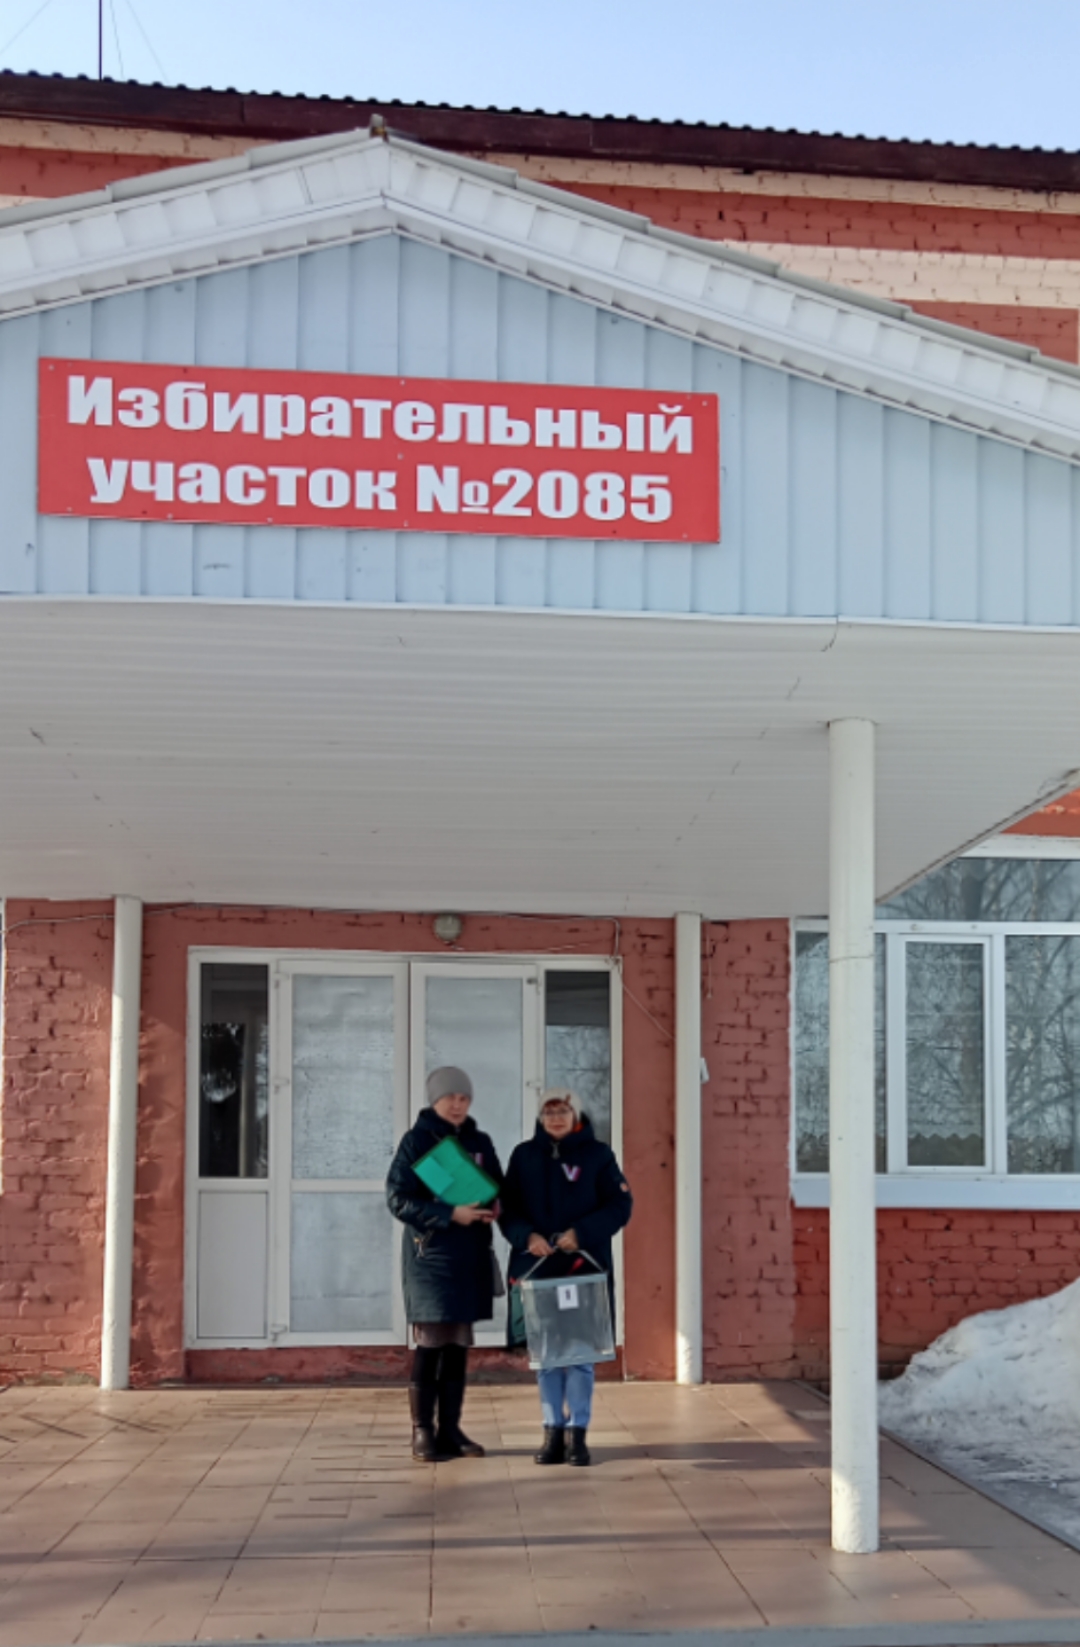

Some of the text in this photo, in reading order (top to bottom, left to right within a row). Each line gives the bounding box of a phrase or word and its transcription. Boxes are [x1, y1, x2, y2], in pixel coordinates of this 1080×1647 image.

[67, 375, 694, 455] Избирательный
[86, 457, 673, 523] участок №2085
